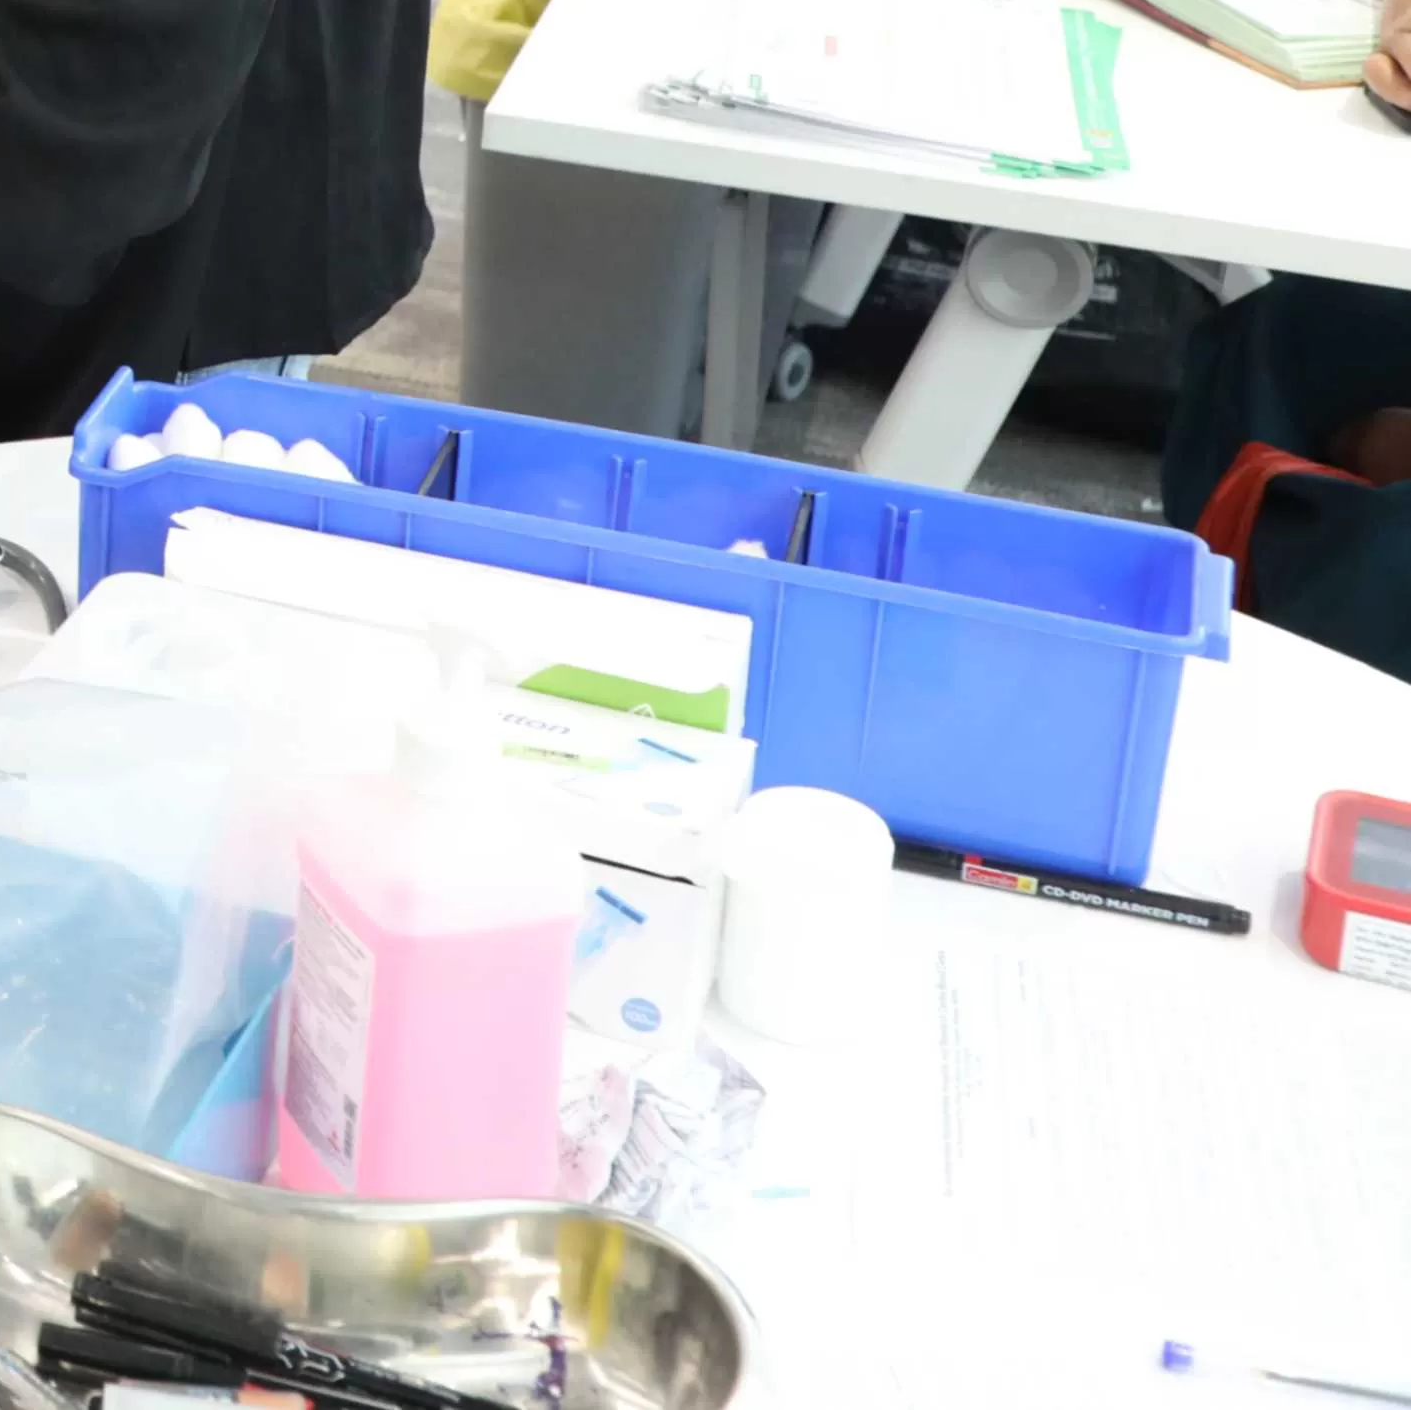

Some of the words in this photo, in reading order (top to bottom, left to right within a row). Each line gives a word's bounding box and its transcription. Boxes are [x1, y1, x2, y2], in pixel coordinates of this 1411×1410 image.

[1041, 884, 1104, 907] CD-DVD
[1105, 895, 1174, 920] MARKER
[1175, 909, 1210, 928] PEN
